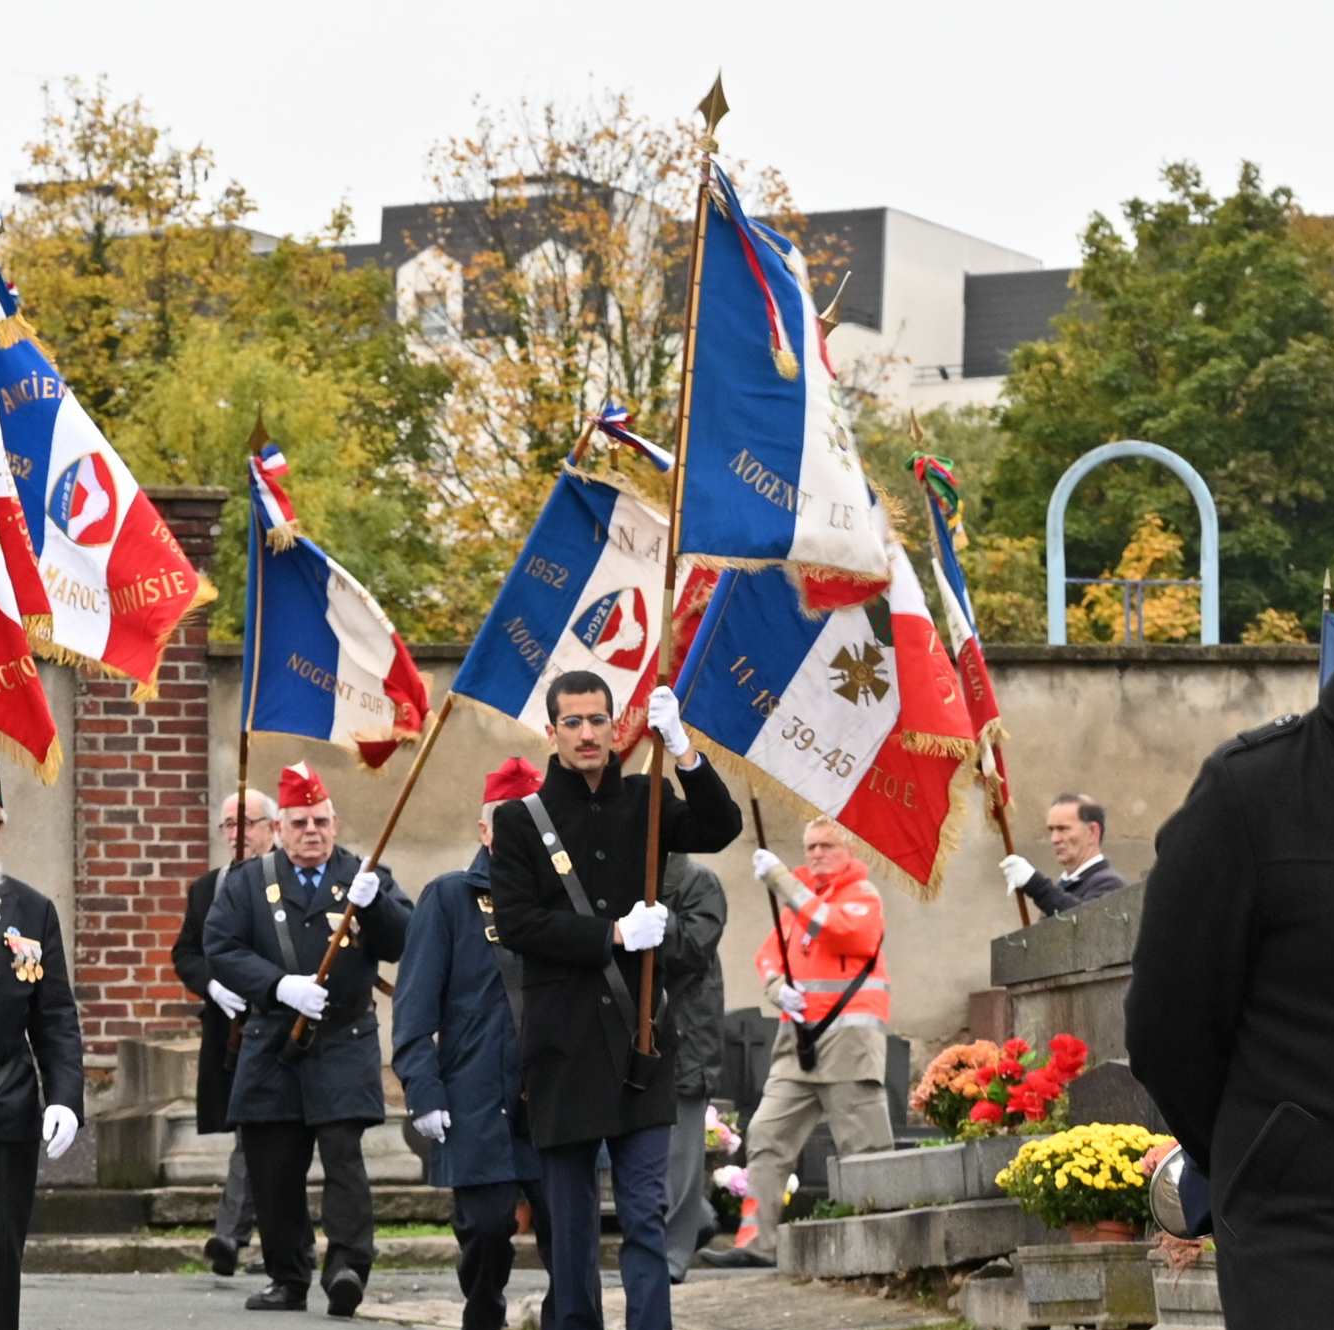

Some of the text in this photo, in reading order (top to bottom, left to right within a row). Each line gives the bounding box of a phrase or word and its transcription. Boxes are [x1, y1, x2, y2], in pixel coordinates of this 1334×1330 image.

[728, 447, 854, 531] NOGENT LE
[524, 556, 570, 590] 1952
[286, 652, 355, 701] NOGENT
[360, 692, 384, 716] SUR
[729, 655, 780, 719] 14-18
[781, 715, 857, 779] 39-45
